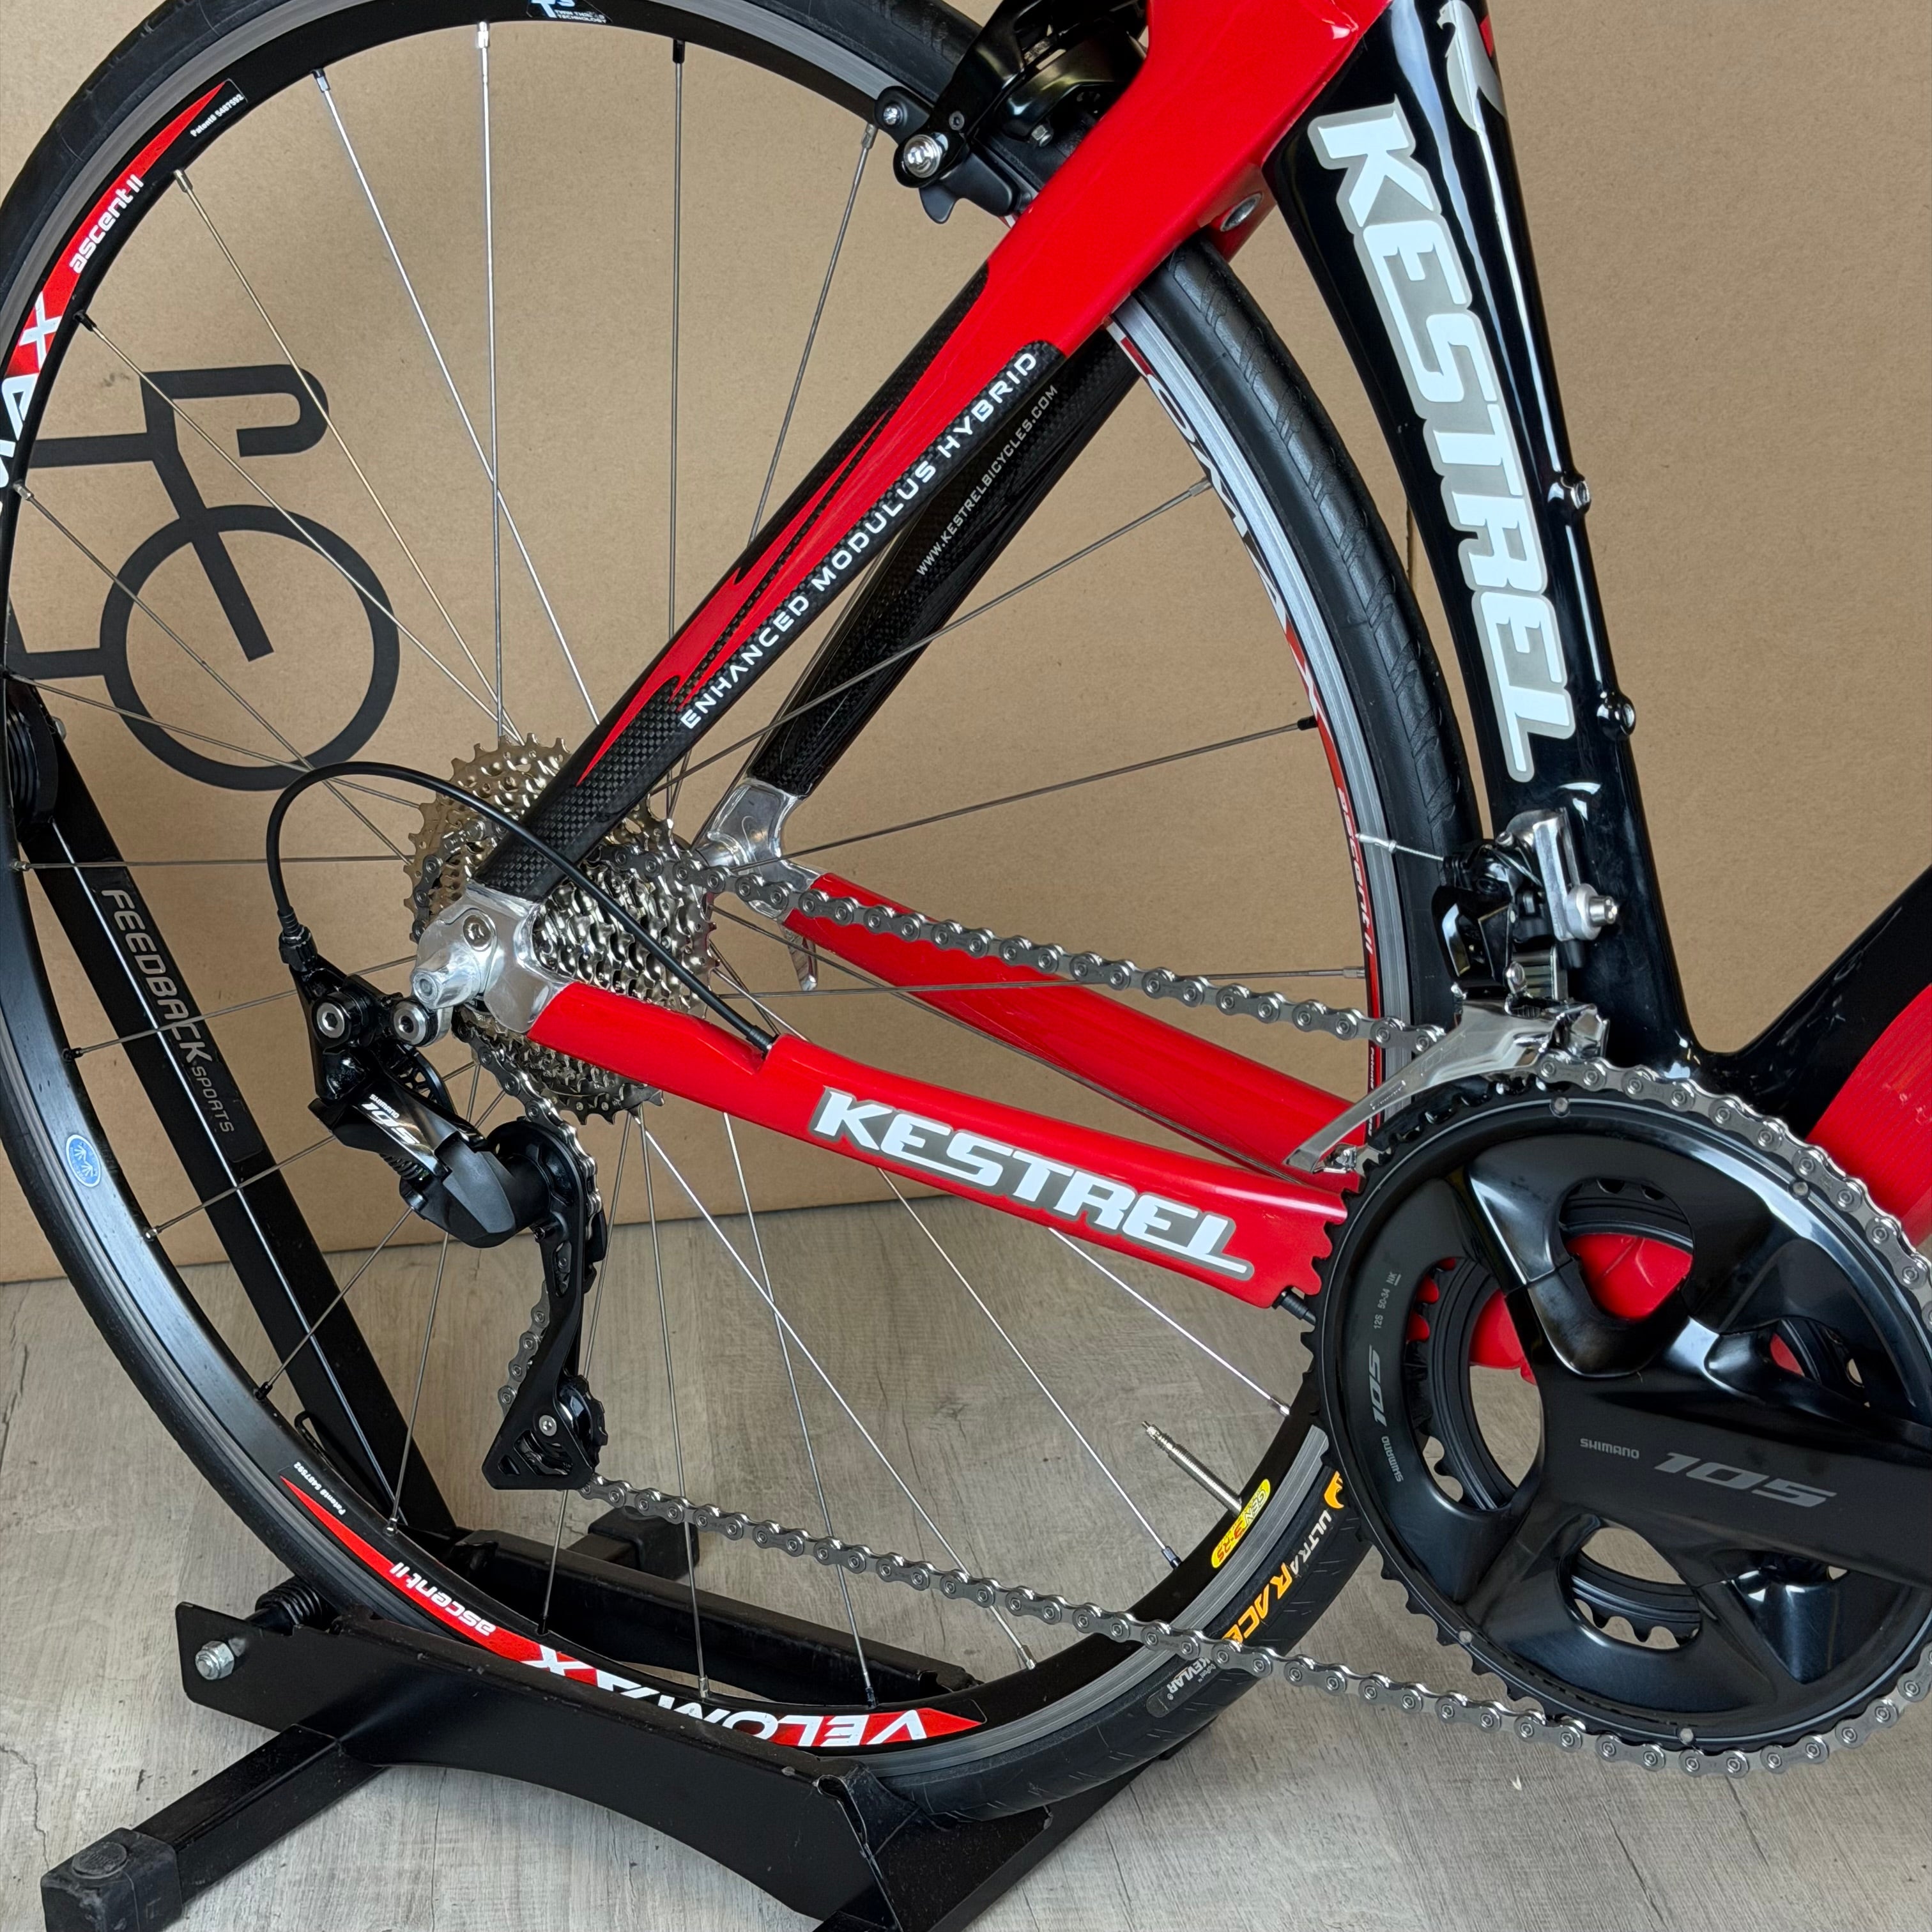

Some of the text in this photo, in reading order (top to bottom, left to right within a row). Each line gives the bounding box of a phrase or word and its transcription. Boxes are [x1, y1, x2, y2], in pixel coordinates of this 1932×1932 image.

[69, 189, 134, 273] ascent
[1308, 95, 1575, 781] KESTREL
[916, 385, 1058, 575] WWW.KESTRELBICYCLES.COM
[680, 352, 1036, 730] ENHANCED MODULUS HYBRID
[101, 890, 234, 1132] FEEDBACK SPORTS
[361, 1102, 420, 1144] 105
[369, 1093, 400, 1119] SHIMANO
[809, 1085, 1254, 1280] KESTREL
[1374, 1314, 1383, 1330] 12S
[1377, 1288, 1390, 1309] 50-34
[1368, 1344, 1404, 1483] SHIMANO 105
[1580, 1438, 1837, 1508] SHIMANO 105
[1289, 1509, 1332, 1575] ULTRA
[406, 1572, 496, 1637] ascent
